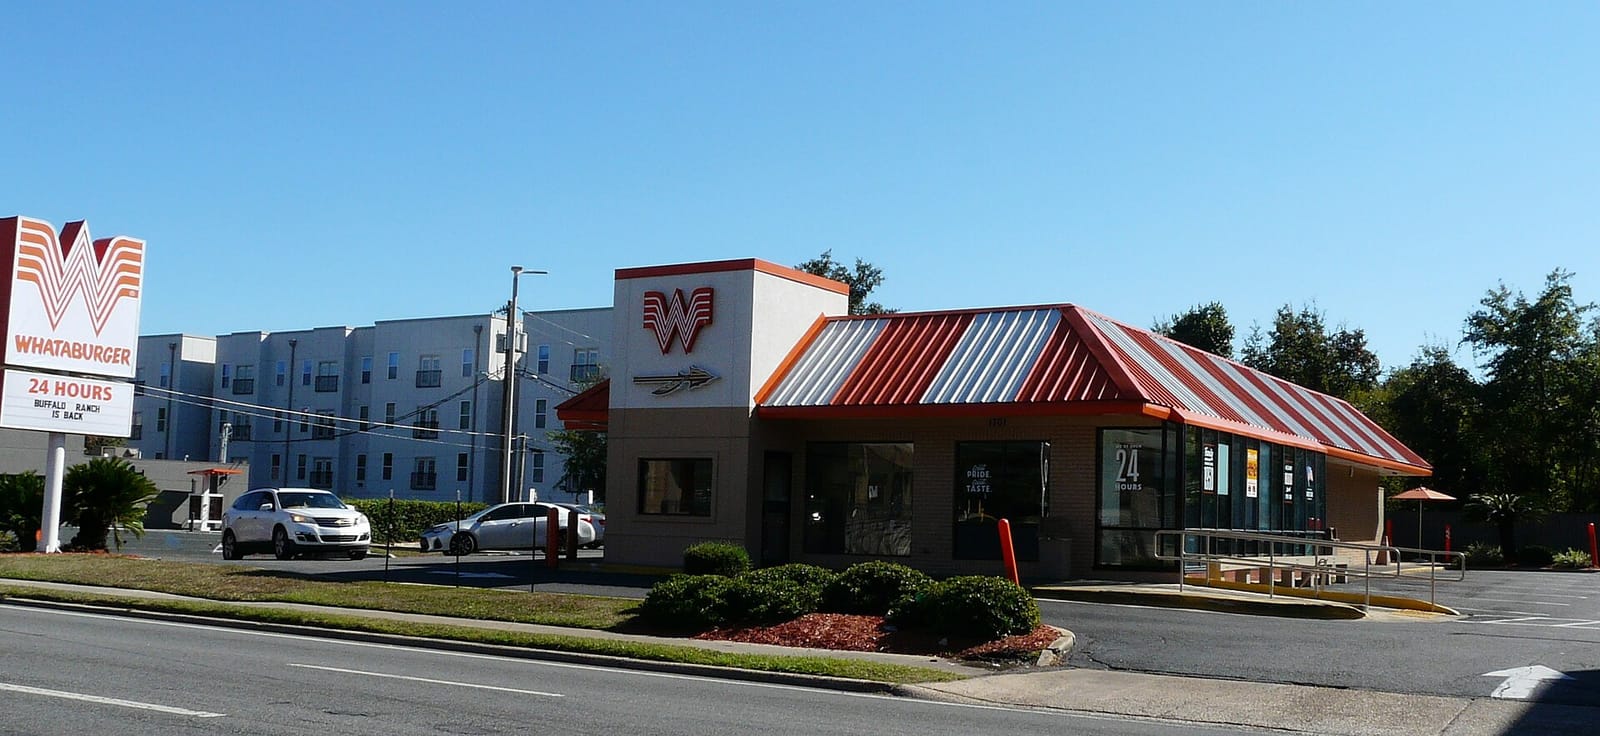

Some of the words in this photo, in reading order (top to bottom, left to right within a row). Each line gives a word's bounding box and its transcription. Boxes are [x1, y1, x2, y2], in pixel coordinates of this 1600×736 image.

[14, 334, 131, 366] WHATABURGER
[28, 378, 49, 395] 24
[54, 380, 113, 401] HOURS
[51, 410, 60, 419] IS
[63, 411, 84, 421] BACK
[75, 403, 101, 413] RANCH
[1115, 448, 1140, 482] 24
[1115, 483, 1142, 491] HOURS
